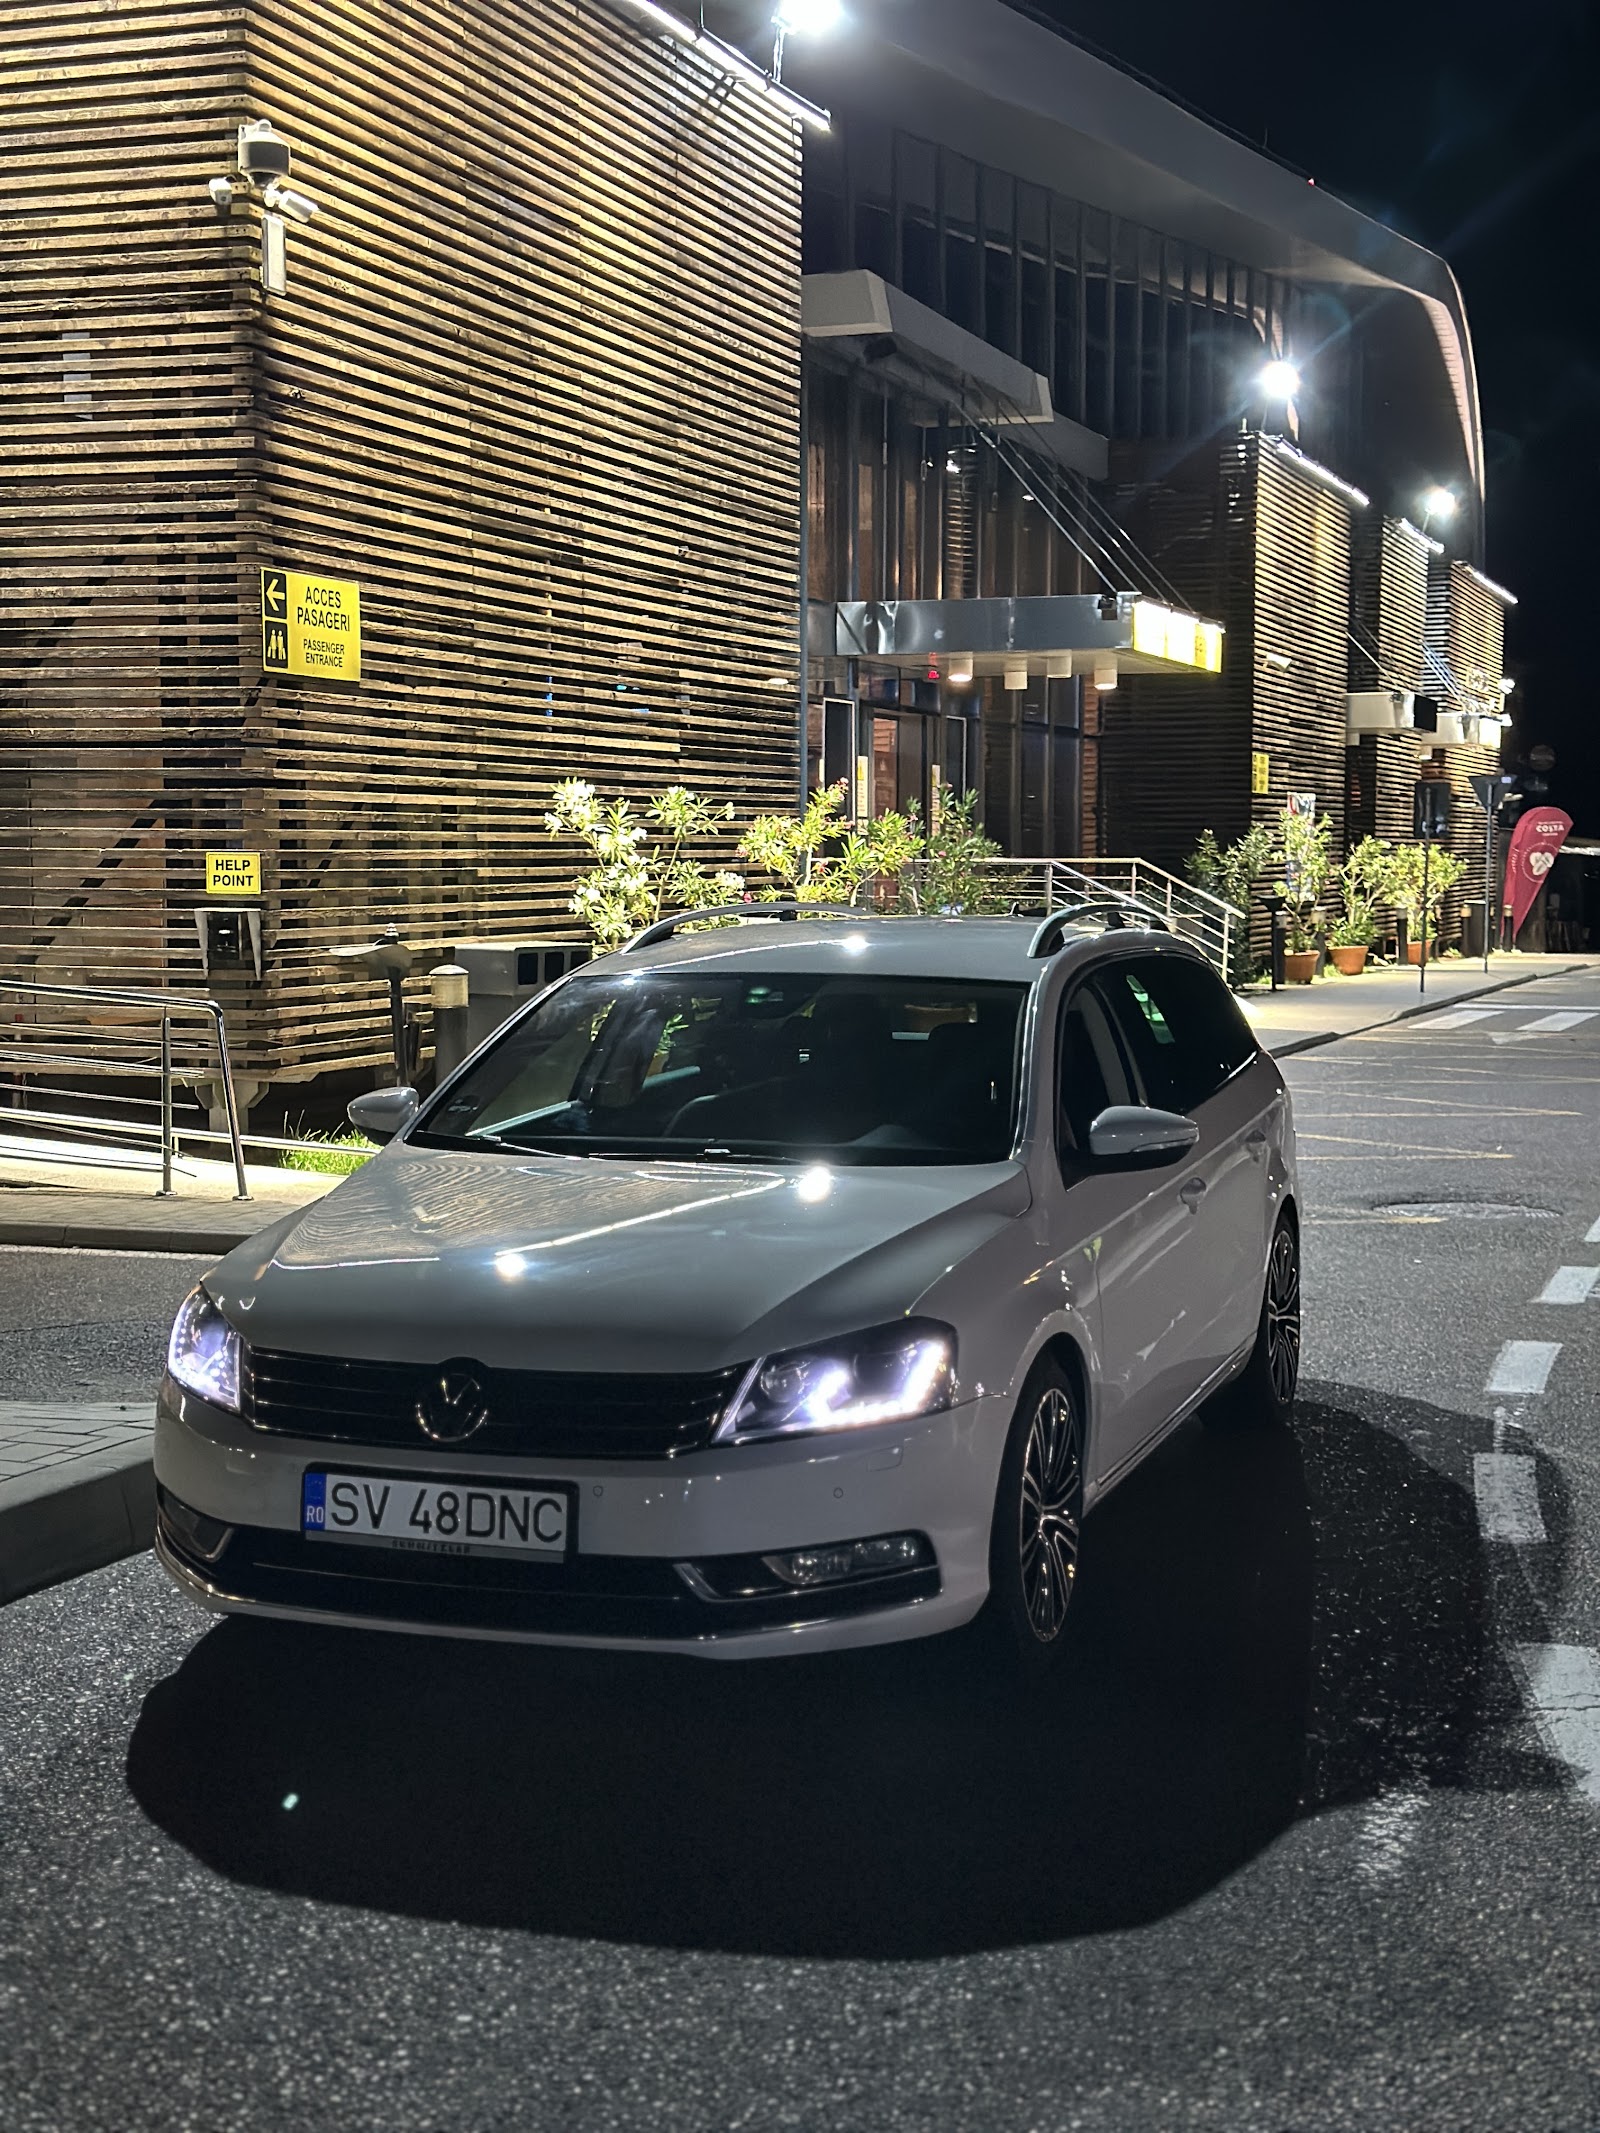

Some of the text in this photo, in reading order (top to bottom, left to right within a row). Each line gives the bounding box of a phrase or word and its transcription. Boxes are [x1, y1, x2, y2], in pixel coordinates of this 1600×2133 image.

[305, 586, 341, 608] ACCES
[297, 606, 350, 632] PASAGERI
[303, 638, 345, 655] PASSENGER
[305, 652, 343, 668] ENTRANCE
[1536, 824, 1564, 832] COSTA
[215, 859, 250, 870] HELP
[213, 875, 253, 886] POINT
[306, 1505, 324, 1524] RO
[331, 1482, 563, 1543] SV 48DNC
